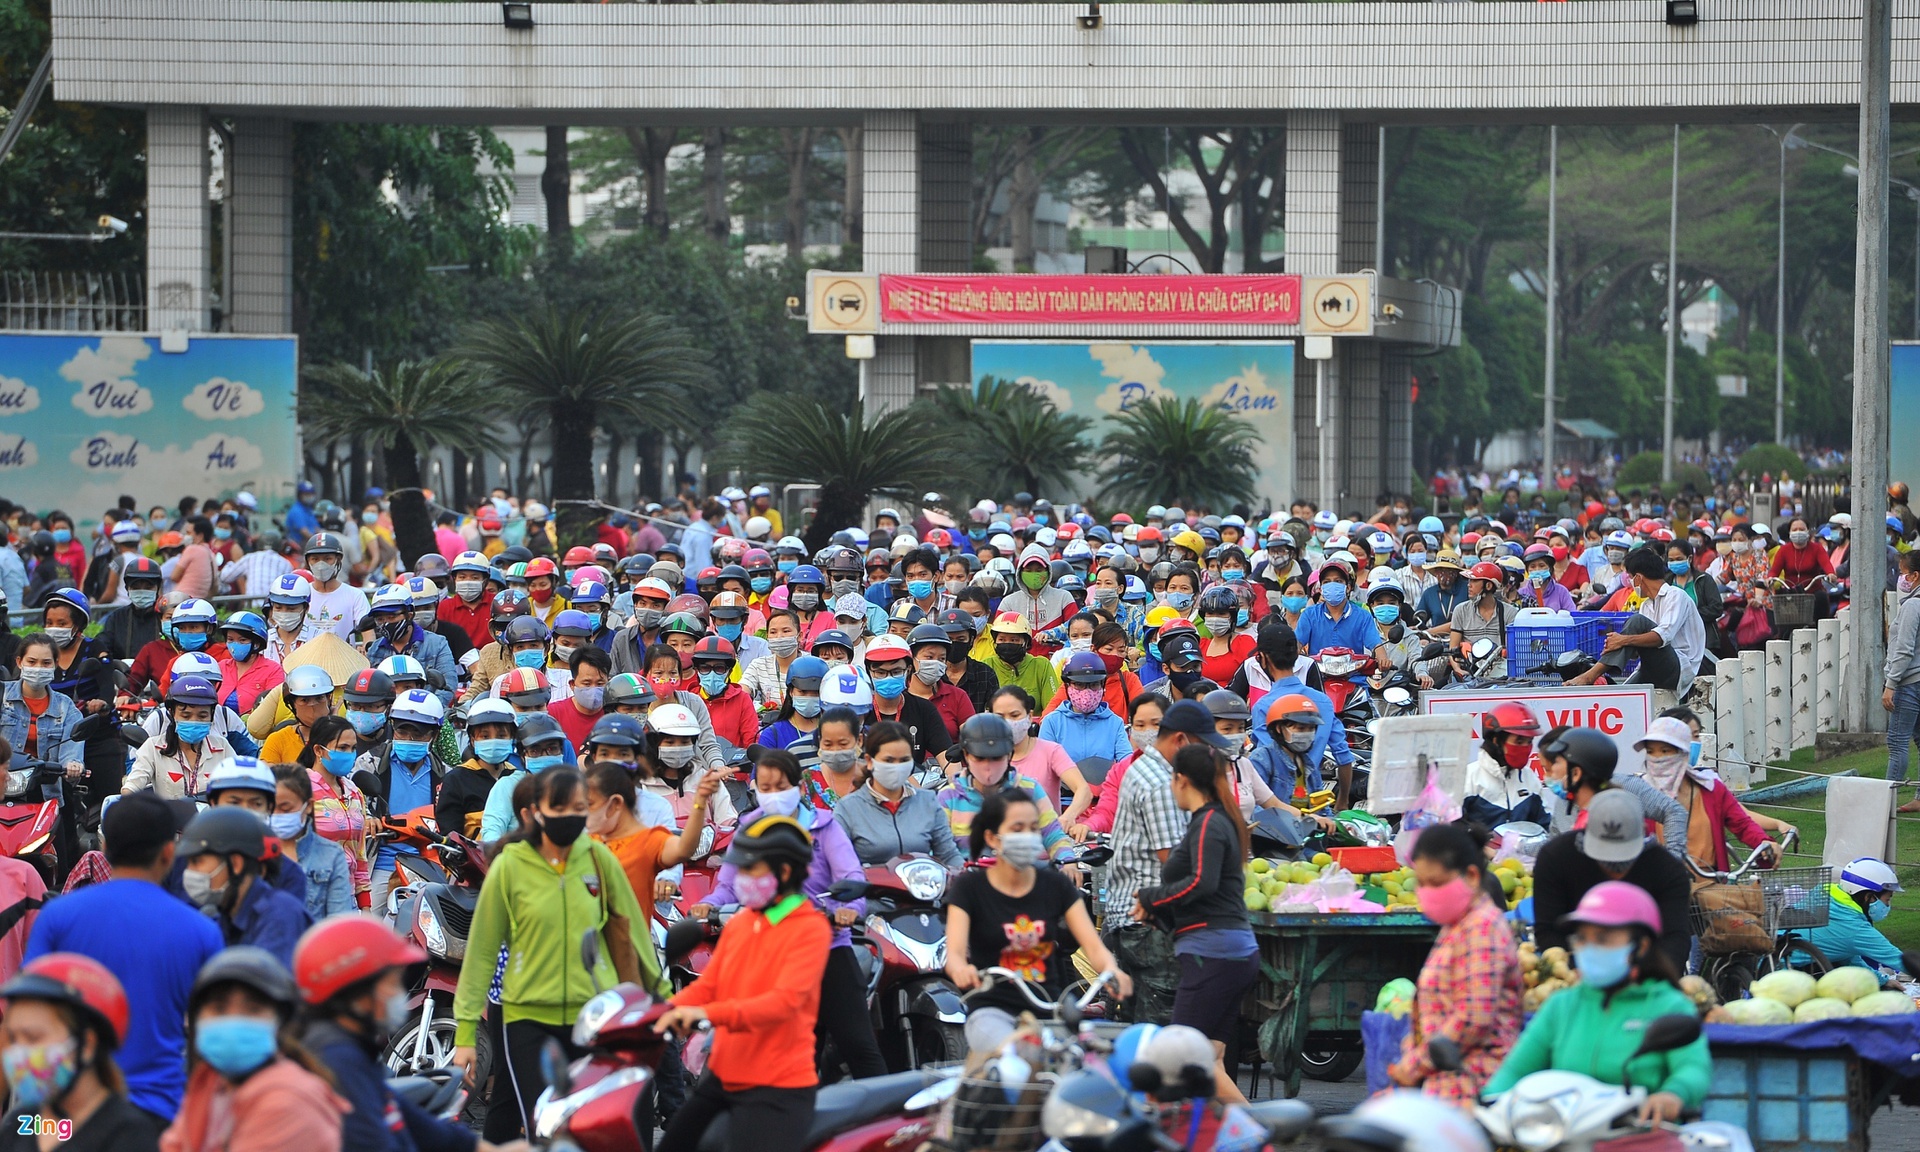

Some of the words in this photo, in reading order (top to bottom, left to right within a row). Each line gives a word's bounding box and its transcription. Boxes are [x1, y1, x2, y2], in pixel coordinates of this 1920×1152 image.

[922, 286, 947, 315] LIỆT
[1016, 286, 1047, 312] NGÀY
[1049, 286, 1078, 312] TOÀN
[1081, 286, 1104, 312] DÂN
[1106, 286, 1145, 312] PHÒNG
[1147, 286, 1177, 312] CHÁY
[1179, 286, 1195, 312] VÀ
[1197, 286, 1228, 312] CHỮA
[1230, 286, 1261, 312] CHÁY
[1262, 291, 1291, 312] 04-10
[0, 386, 27, 408] ui
[88, 381, 138, 409] Vui
[1220, 382, 1278, 411] Làm
[87, 437, 138, 468] Bình
[205, 440, 237, 470] An
